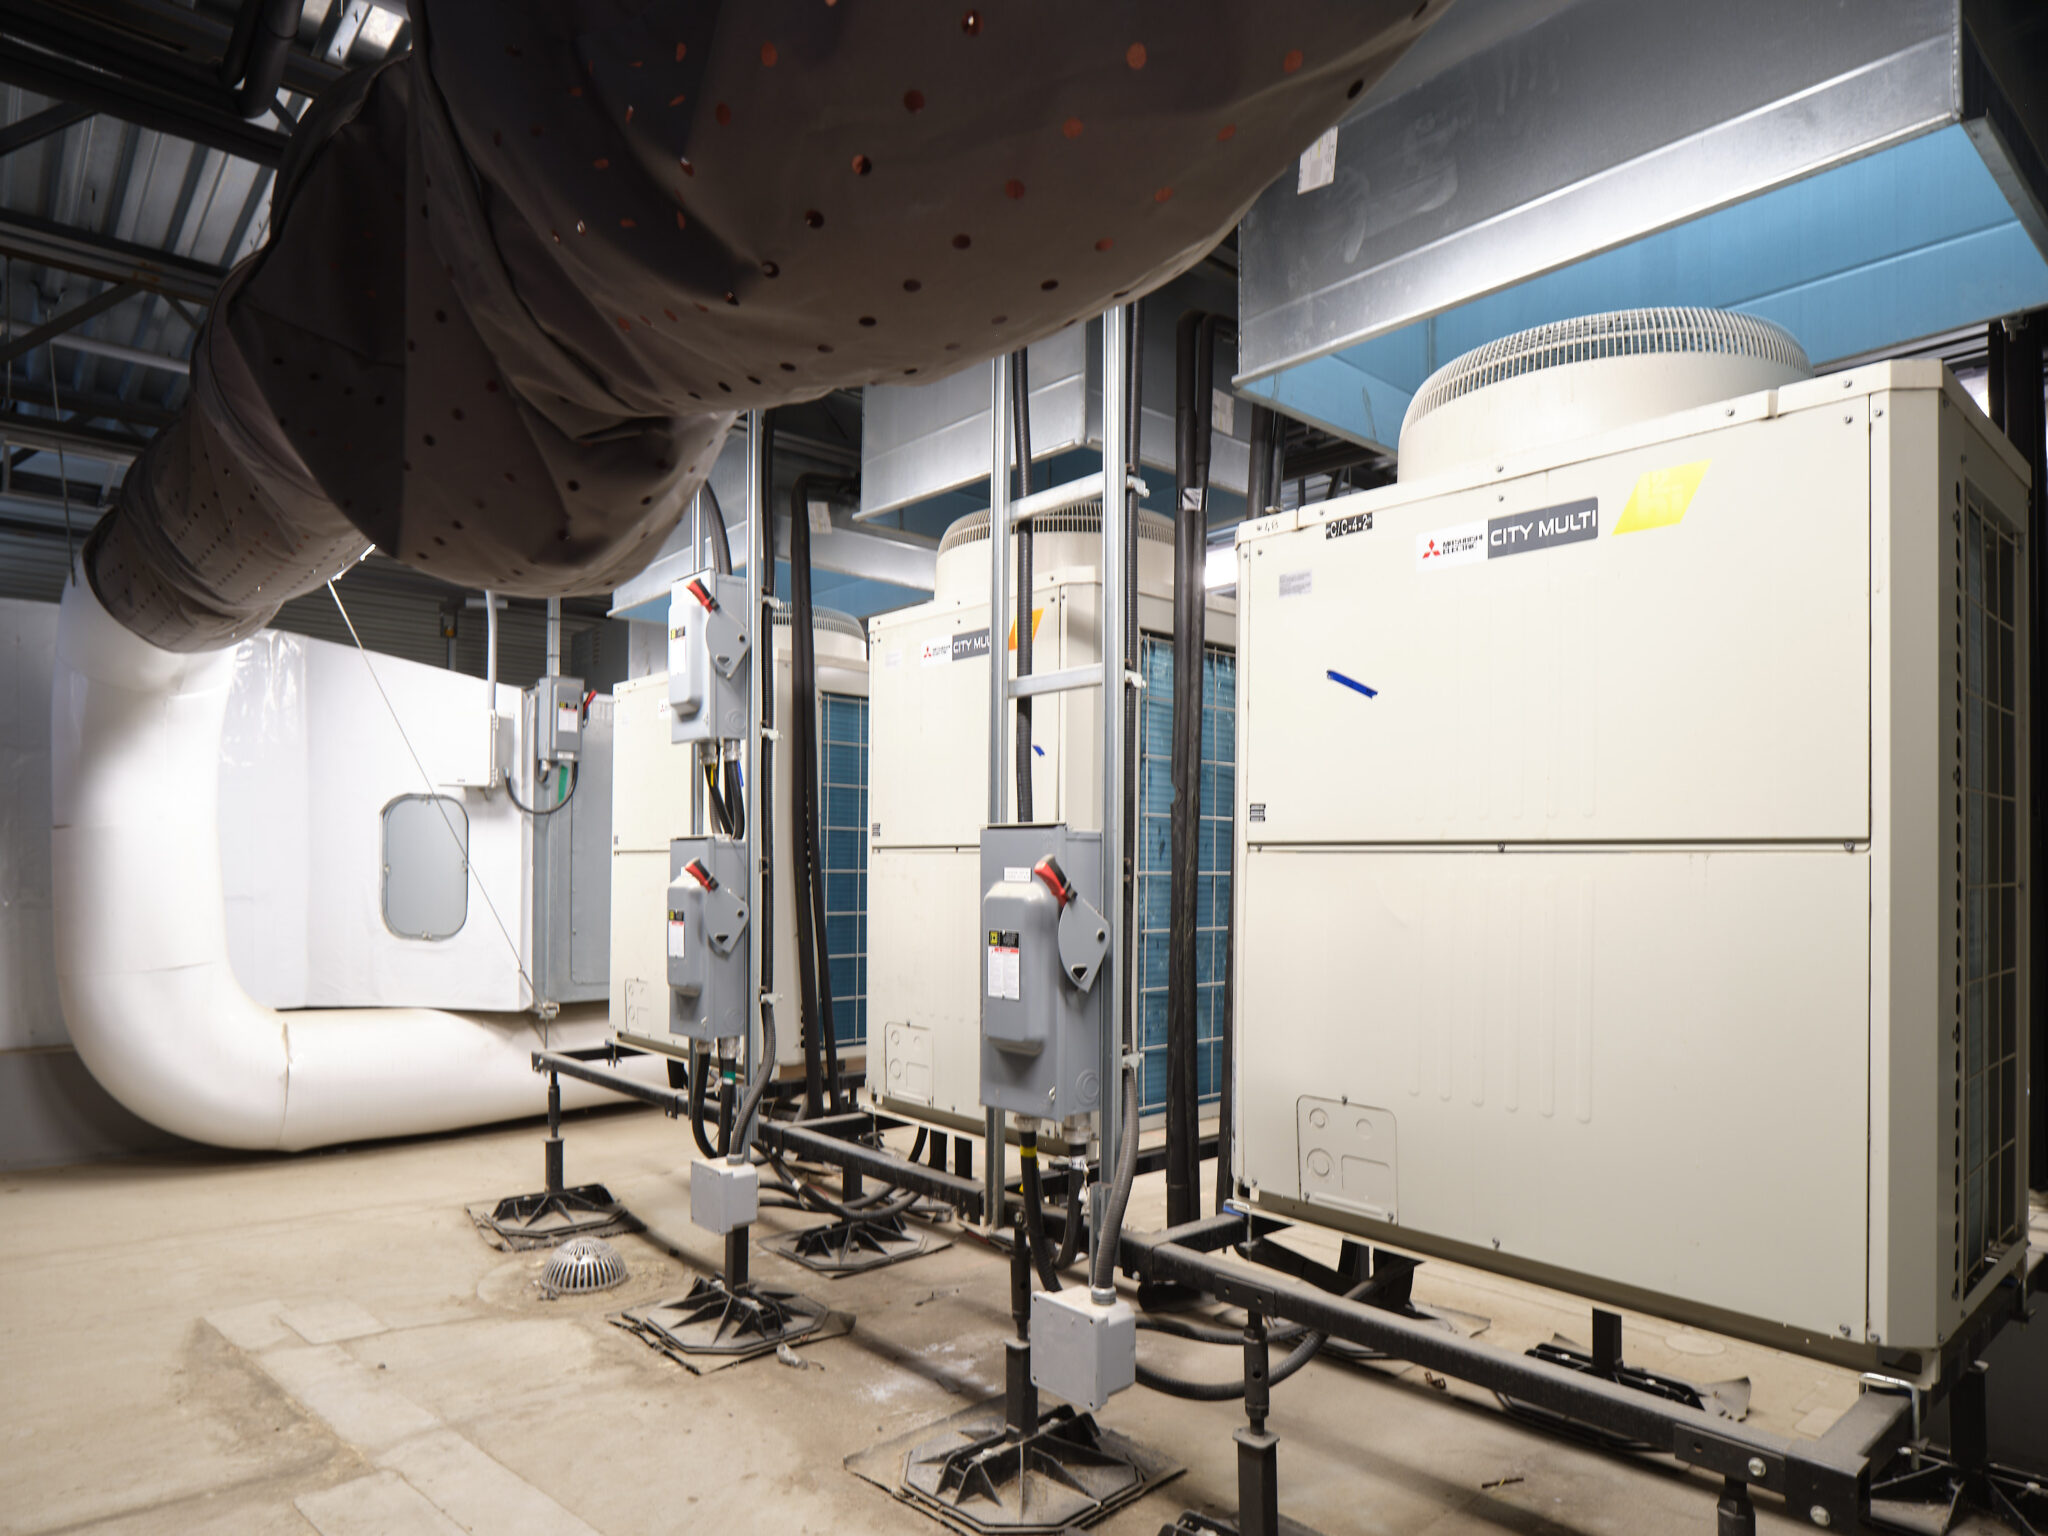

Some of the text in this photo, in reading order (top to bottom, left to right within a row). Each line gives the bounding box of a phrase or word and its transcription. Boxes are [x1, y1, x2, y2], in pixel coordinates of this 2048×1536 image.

[1490, 509, 1597, 546] CITY MULTI
[953, 639, 972, 653] CITY
